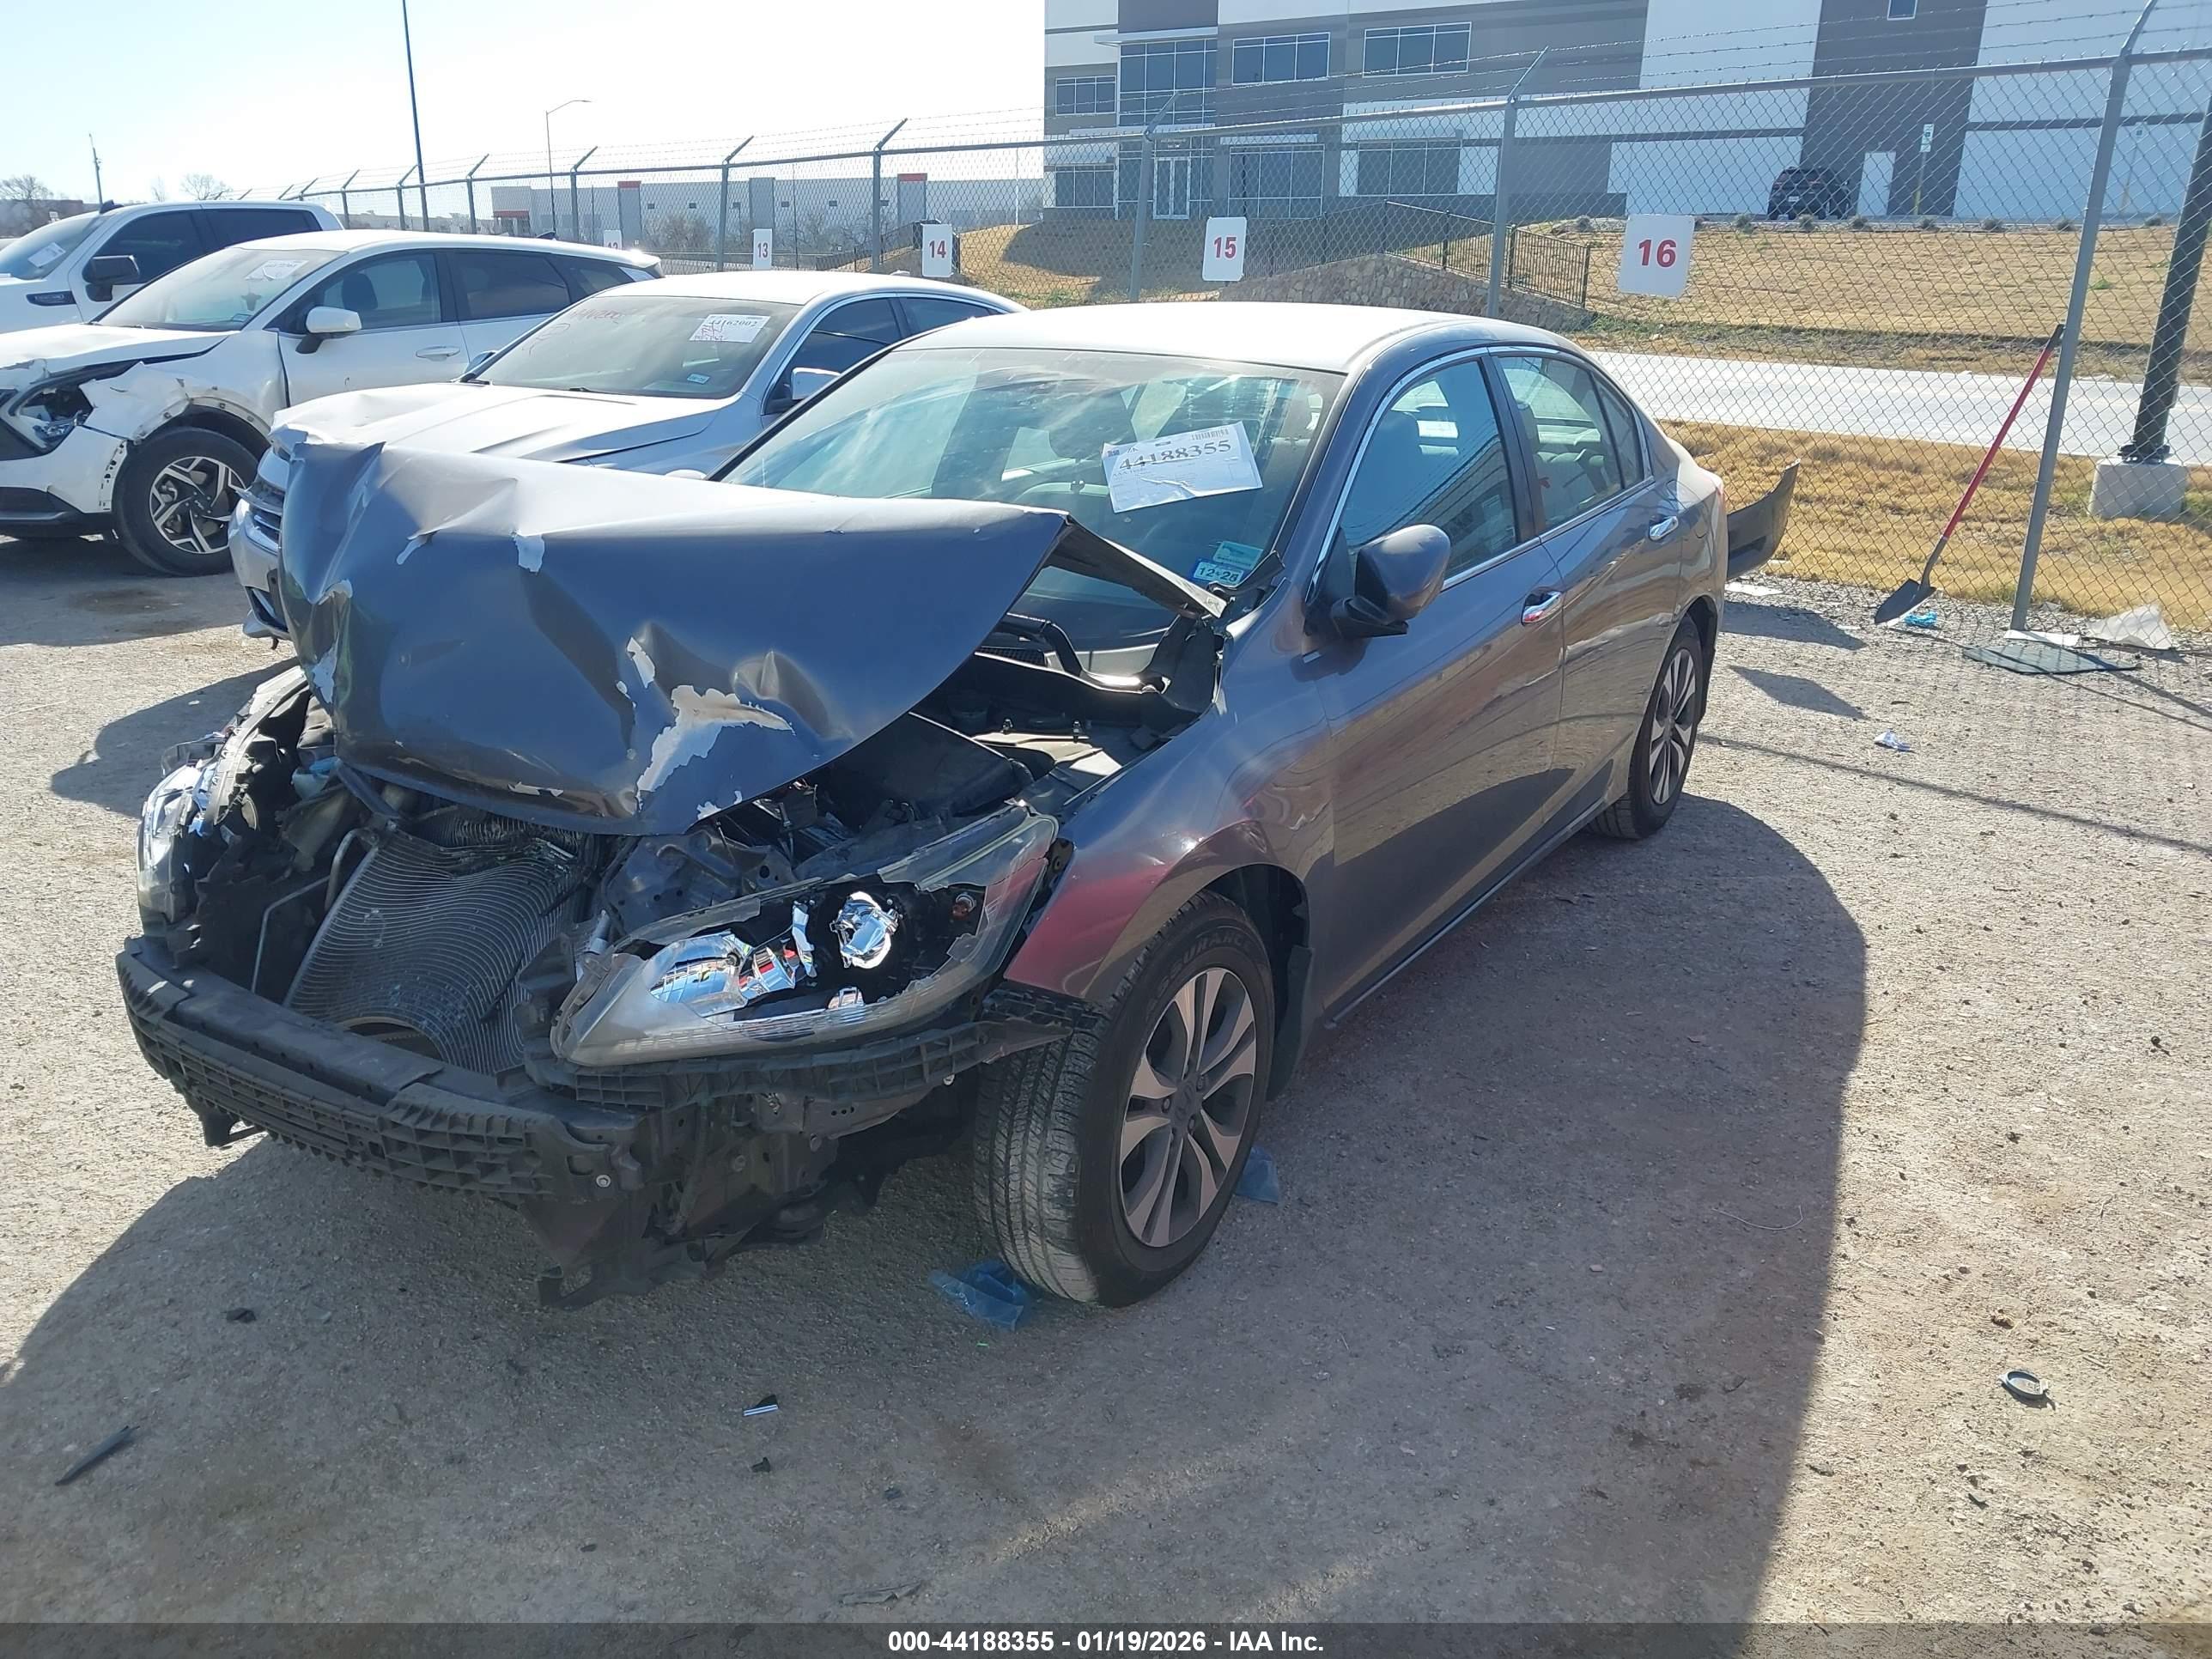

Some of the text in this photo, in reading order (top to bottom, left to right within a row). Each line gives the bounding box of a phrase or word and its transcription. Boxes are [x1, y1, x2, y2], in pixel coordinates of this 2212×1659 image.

[757, 242, 769, 258] 13
[929, 240, 946, 258] 14
[1213, 236, 1237, 259] 15
[1638, 239, 1677, 268] 16
[1119, 439, 1231, 470] 44188355
